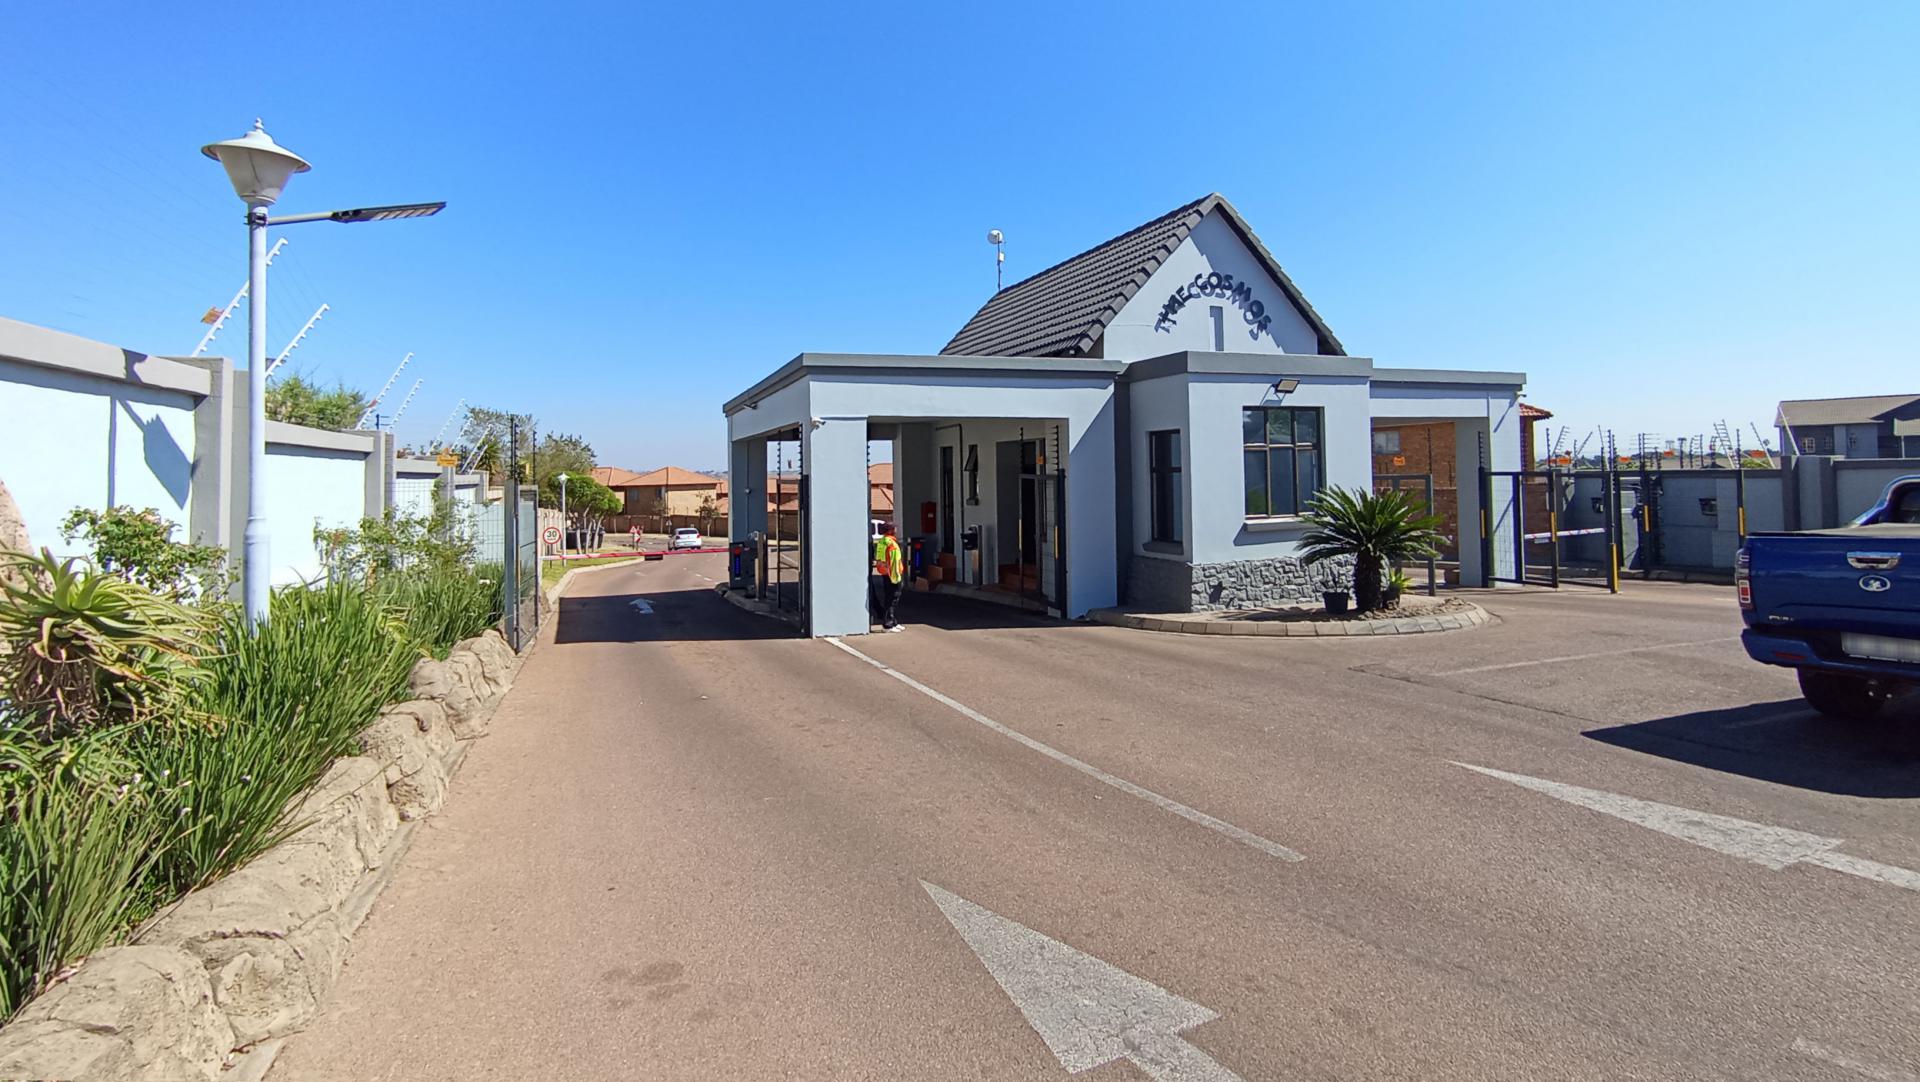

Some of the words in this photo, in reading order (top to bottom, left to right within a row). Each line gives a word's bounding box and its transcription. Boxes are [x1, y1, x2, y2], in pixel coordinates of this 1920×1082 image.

[1156, 286, 1192, 328] THE
[1192, 271, 1272, 336] COSMOS
[546, 530, 557, 538] 30
